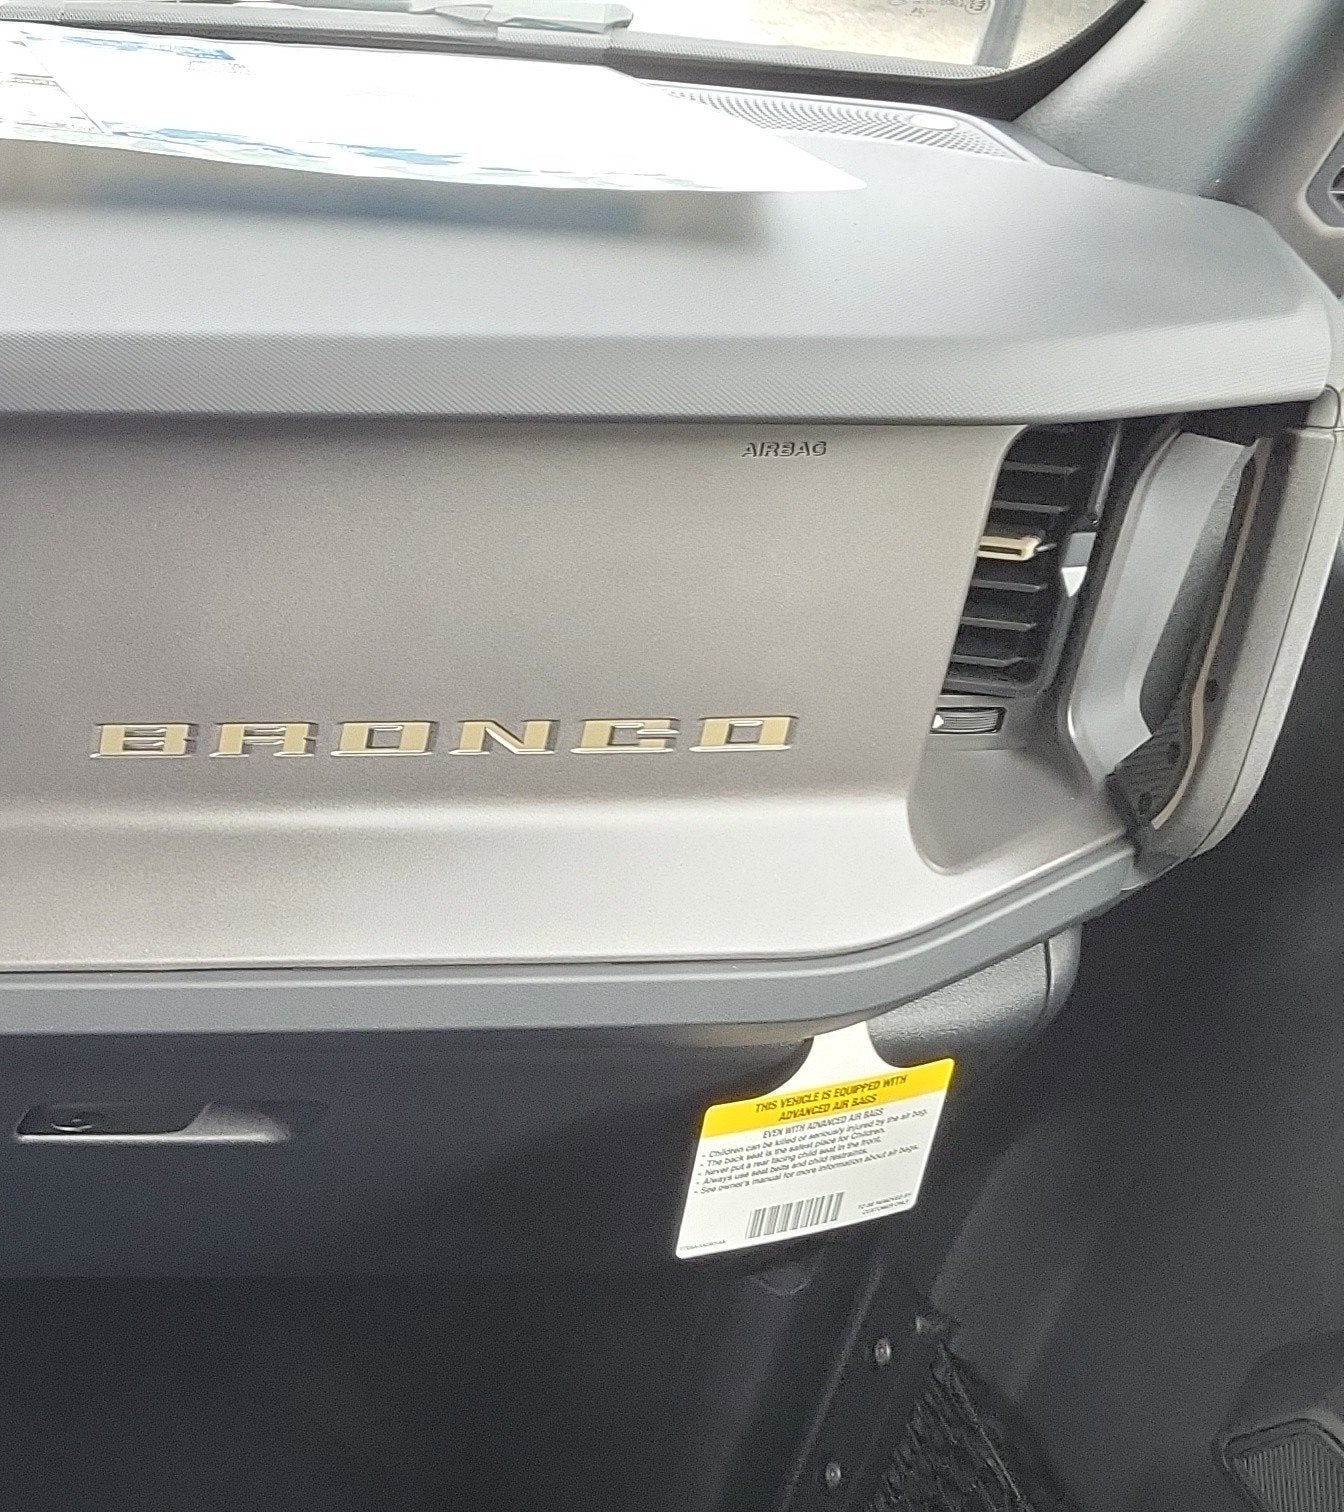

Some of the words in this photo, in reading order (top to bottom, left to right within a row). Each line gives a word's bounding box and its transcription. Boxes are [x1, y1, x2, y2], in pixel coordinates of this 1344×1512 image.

[741, 440, 828, 460] AIRBAG
[90, 715, 799, 758] BRONCO
[780, 1092, 819, 1107] VEHICLE
